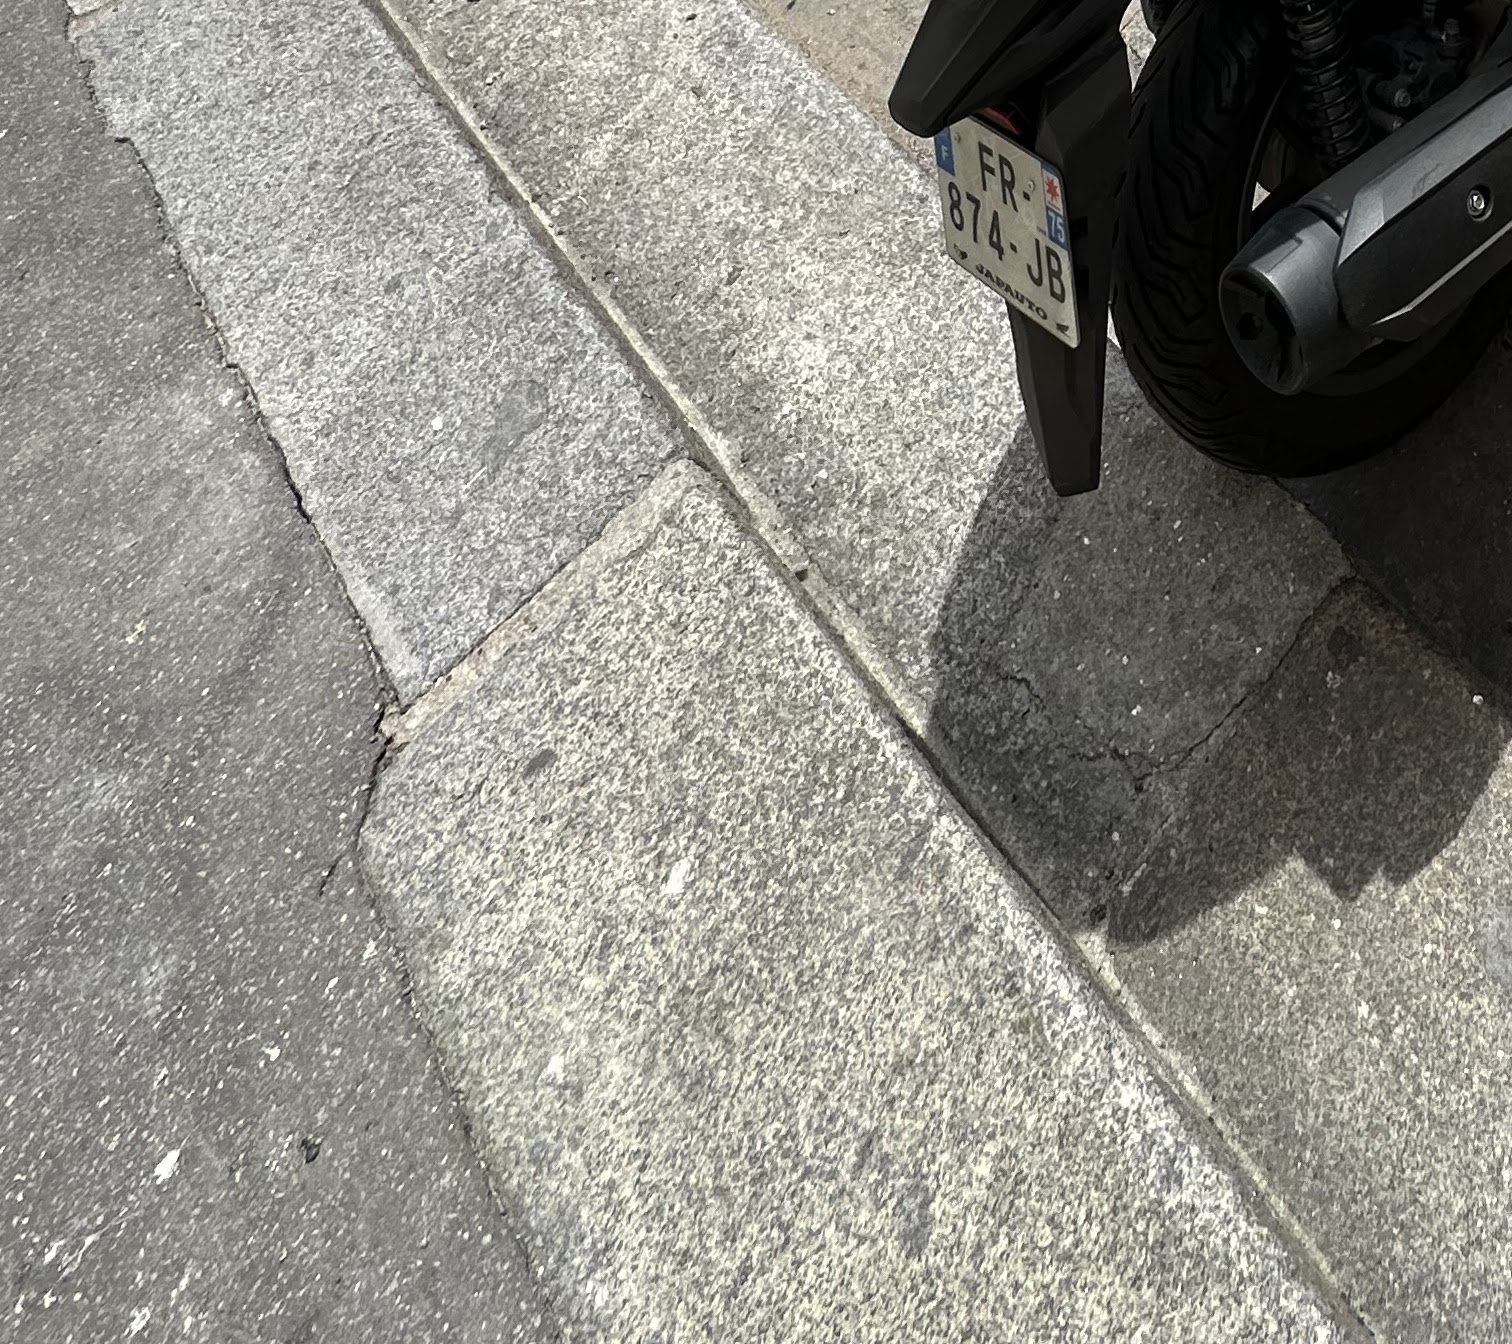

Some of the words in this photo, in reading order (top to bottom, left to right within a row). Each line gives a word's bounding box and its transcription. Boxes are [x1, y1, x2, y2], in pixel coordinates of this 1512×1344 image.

[940, 144, 949, 162] F
[977, 141, 1031, 213] FR-
[947, 181, 1066, 304] 874-JB
[1047, 211, 1066, 243] 75
[975, 262, 1049, 321] JAPAUTO
